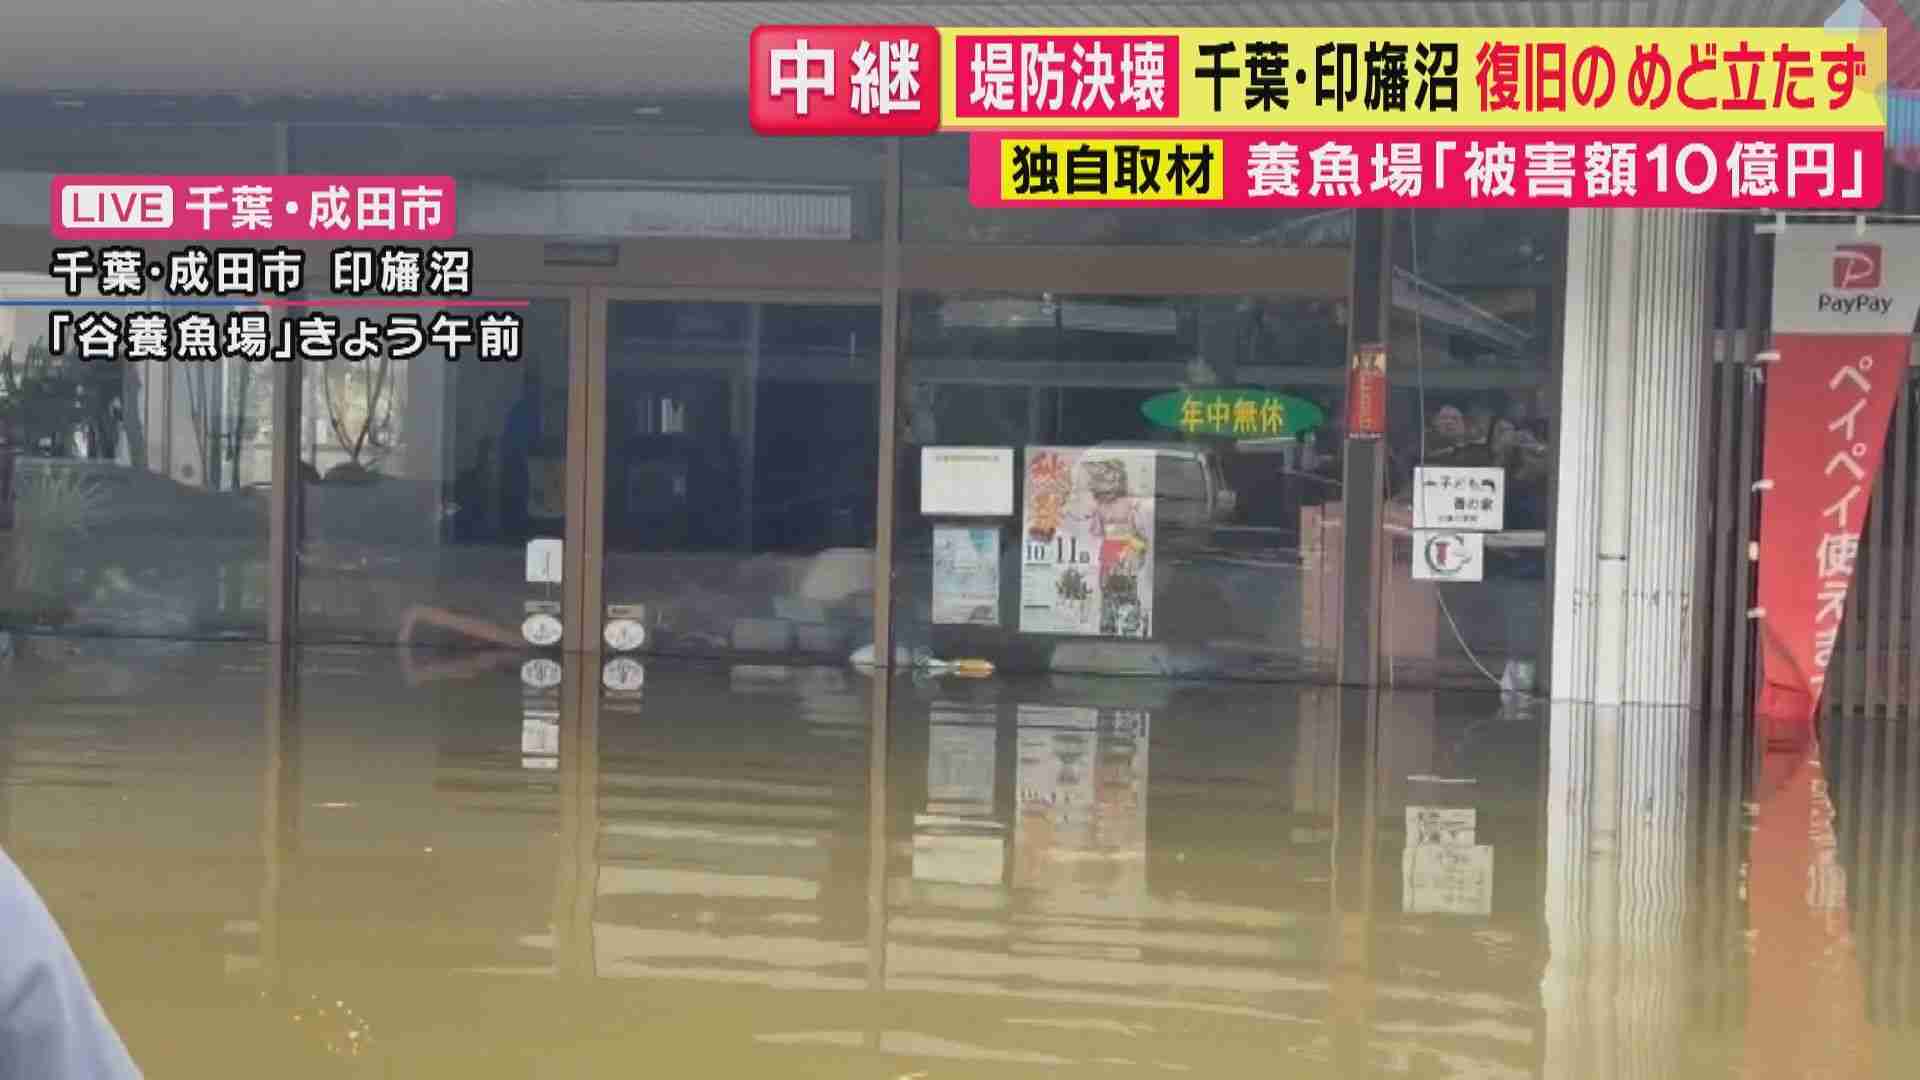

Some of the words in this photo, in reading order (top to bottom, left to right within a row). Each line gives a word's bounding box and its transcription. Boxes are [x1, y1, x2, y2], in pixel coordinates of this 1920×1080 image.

[1818, 294, 1893, 315] PayPay
[1179, 397, 1285, 433] 年中無休
